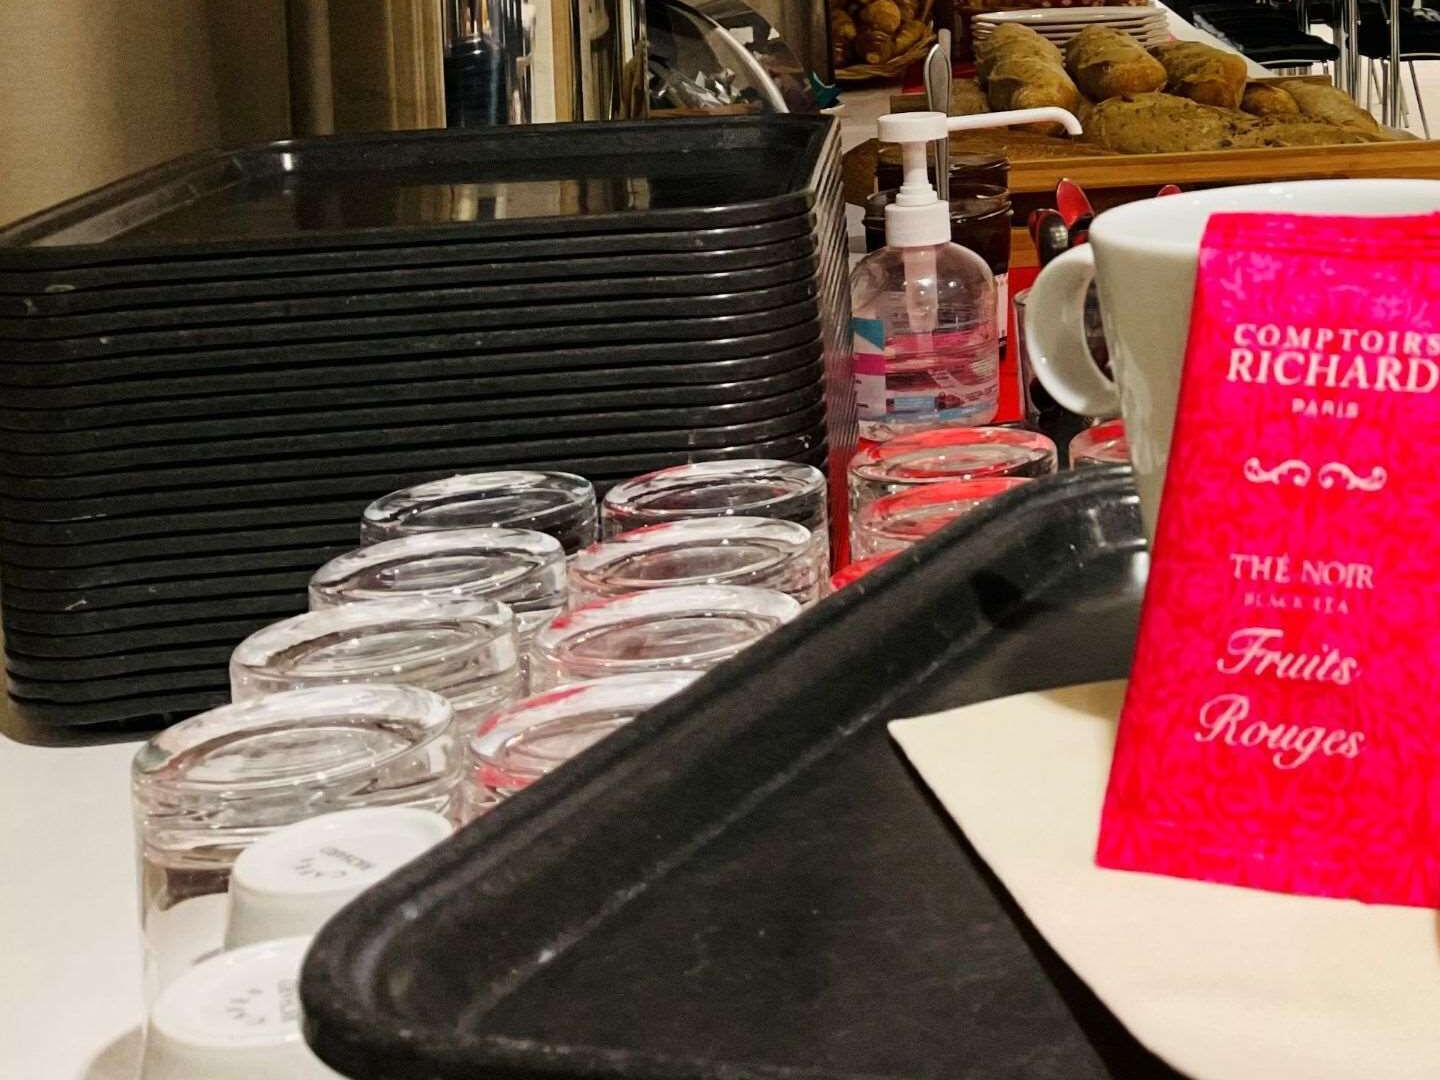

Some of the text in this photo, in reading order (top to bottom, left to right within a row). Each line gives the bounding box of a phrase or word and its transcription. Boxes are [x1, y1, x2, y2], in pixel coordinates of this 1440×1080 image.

[1225, 348, 1440, 394] RICHARD
[1291, 397, 1360, 419] PARIS
[1229, 553, 1375, 590] THÉ NOIR
[1312, 595, 1349, 615] TEA
[1216, 626, 1358, 686] Fruits
[1194, 693, 1366, 770] Rouges
